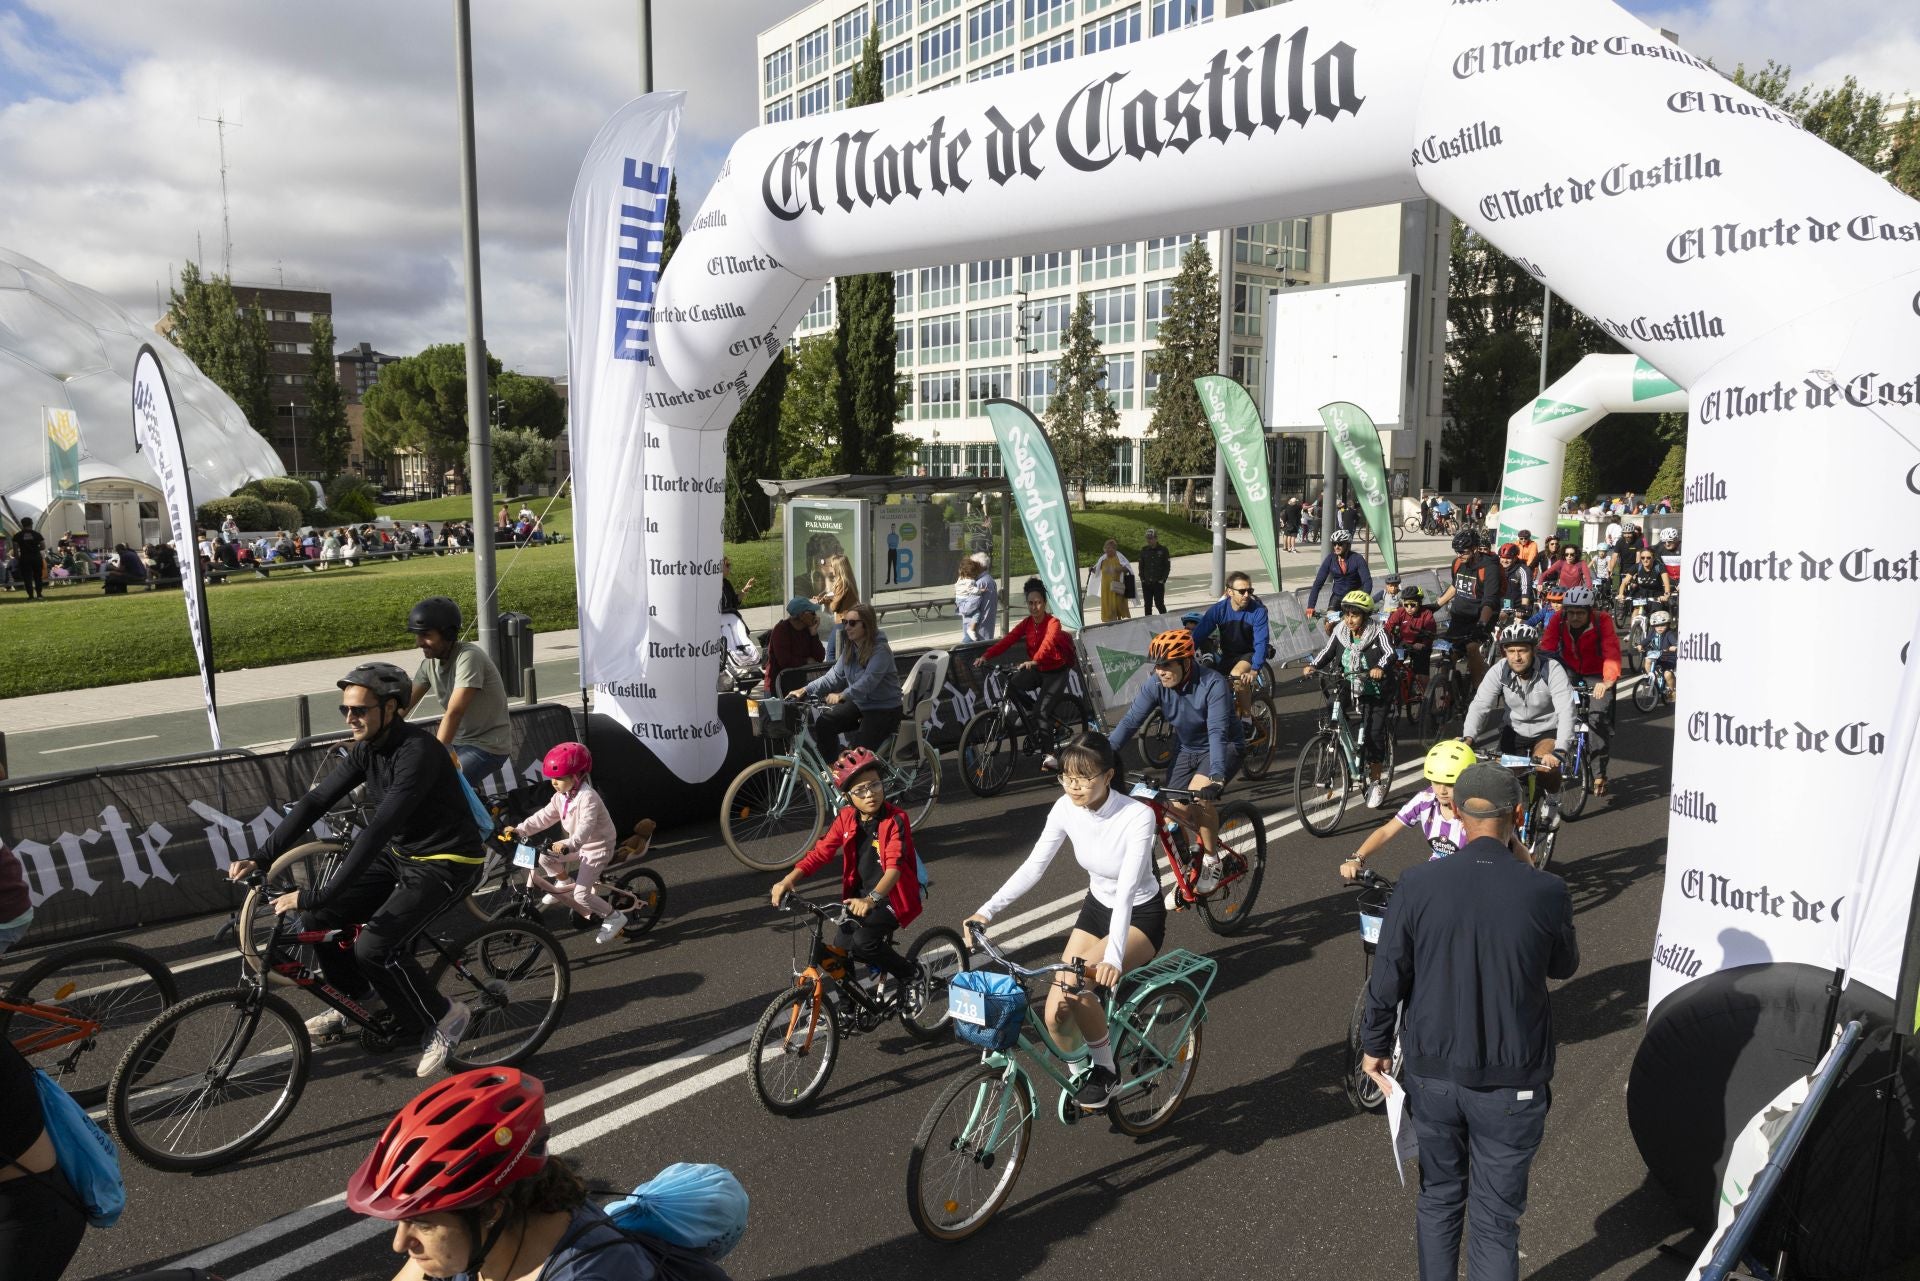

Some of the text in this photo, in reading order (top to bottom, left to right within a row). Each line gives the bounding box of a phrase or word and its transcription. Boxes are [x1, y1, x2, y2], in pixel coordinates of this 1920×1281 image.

[1453, 45, 1484, 79] El
[1490, 35, 1565, 69] Norte
[1569, 34, 1599, 56] de
[1667, 90, 1704, 113] El
[762, 26, 1366, 221] El Norte de Castilla
[1422, 120, 1503, 164] Castilla
[1479, 152, 1723, 223] El Norte de Castilla
[1666, 227, 1704, 264] El
[1713, 217, 1801, 259] Norte
[1806, 215, 1842, 247] de
[707, 253, 784, 275] El Norte d
[674, 307, 687, 322] de
[688, 302, 746, 322] Castilla
[1631, 310, 1726, 342] Castilla
[729, 339, 749, 356] El
[656, 390, 695, 408] Norte
[695, 388, 711, 400] de
[1701, 391, 1720, 425] El
[1725, 380, 1798, 417] Norte
[1804, 378, 1838, 409] de
[652, 474, 690, 492] Norte
[691, 477, 703, 493] de
[1685, 472, 1727, 505] astilla
[650, 559, 688, 576] Norte
[690, 561, 703, 576] de
[1693, 550, 1713, 583] El
[1718, 550, 1792, 582] Norte
[1798, 551, 1834, 582] de
[648, 641, 687, 658] Norte
[688, 643, 701, 657] de
[1678, 632, 1722, 663] astilla
[608, 681, 657, 699] Castilla
[632, 722, 649, 738] El
[650, 723, 689, 740] Norte
[690, 724, 703, 739] de
[1688, 711, 1709, 743] El
[1713, 712, 1789, 751] Norte
[1794, 721, 1829, 754] de
[12, 805, 180, 907] orte
[1681, 869, 1705, 902] El
[1708, 873, 1785, 918] Norte
[1790, 891, 1825, 924] de
[955, 1000, 978, 1017] 718
[495, 1129, 536, 1185] ROCKRIDER
